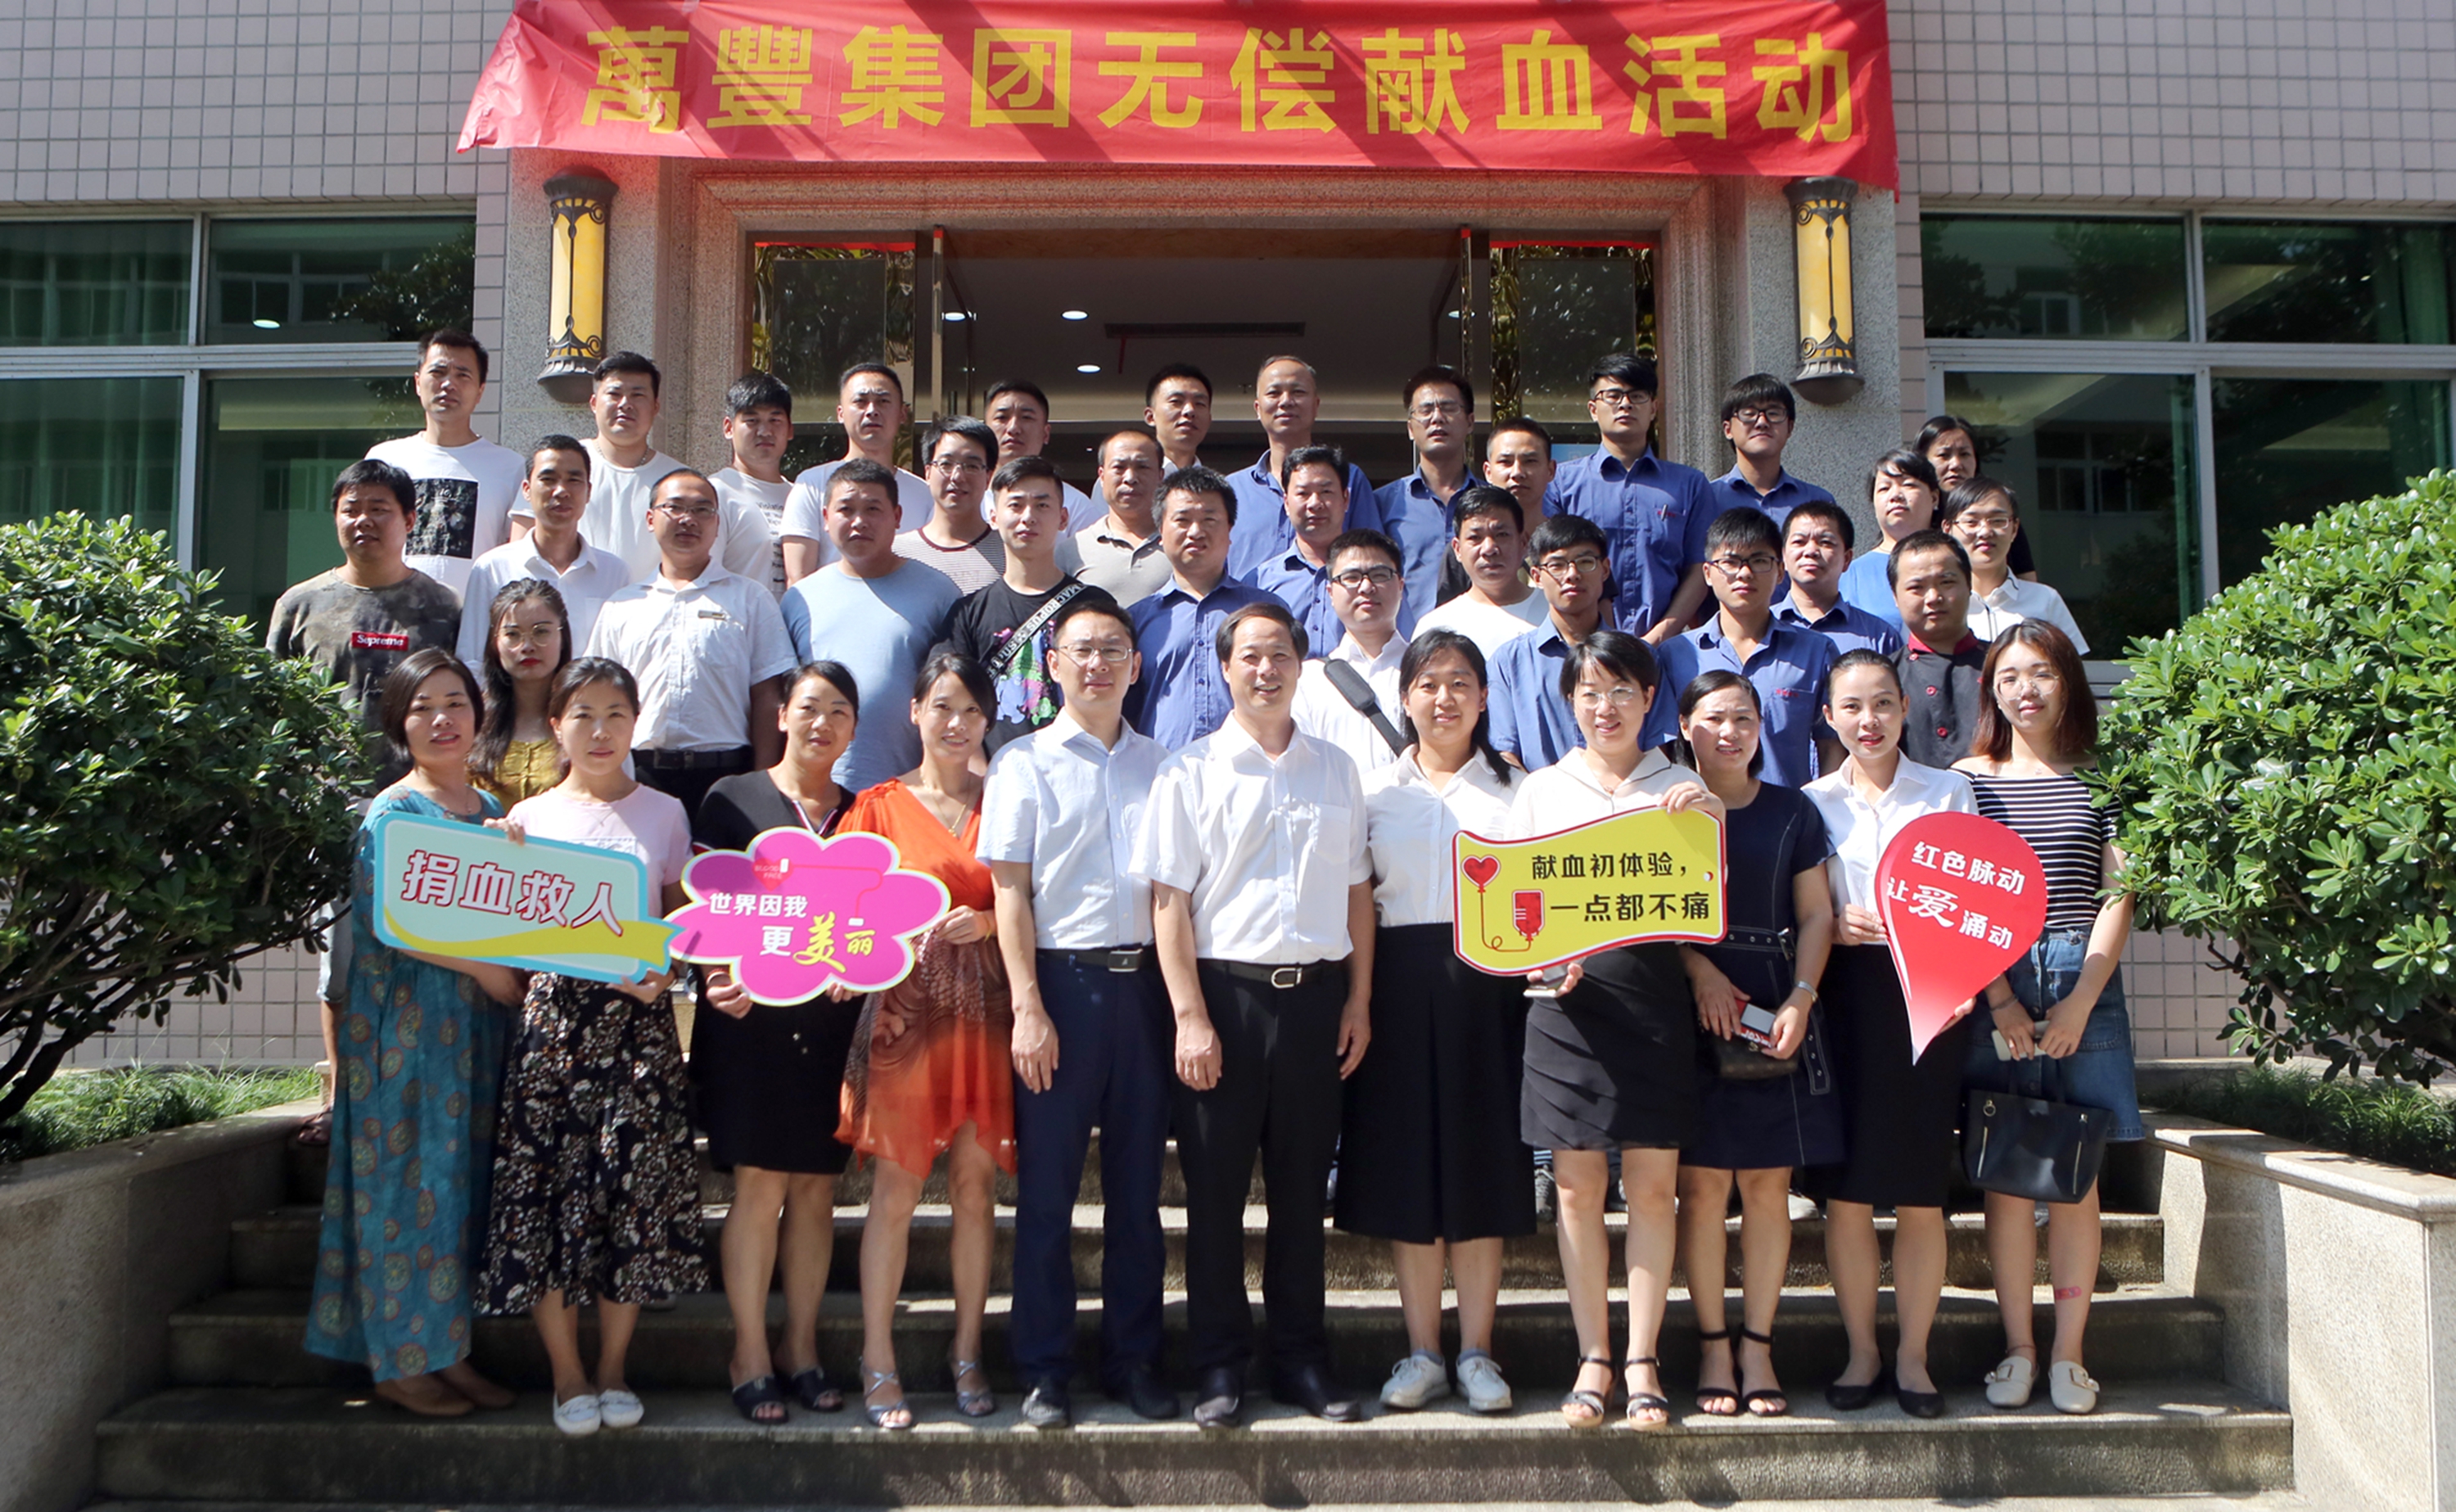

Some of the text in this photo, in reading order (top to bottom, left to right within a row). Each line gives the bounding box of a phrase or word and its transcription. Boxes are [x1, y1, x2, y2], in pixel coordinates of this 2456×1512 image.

[580, 24, 1853, 143] 萬豐集团无偿献血活动
[1025, 583, 1082, 632] MACROPUS
[356, 634, 404, 648] Supreme
[1531, 851, 1687, 880] 献血初体验，
[1911, 841, 2026, 896] 红色脉动
[400, 849, 624, 937] 捐血救人
[709, 892, 808, 918] 世界因我
[1550, 891, 1710, 923] 一点都不痛
[1885, 877, 2014, 950] 让爱涌动
[759, 910, 876, 973] 更美丽
